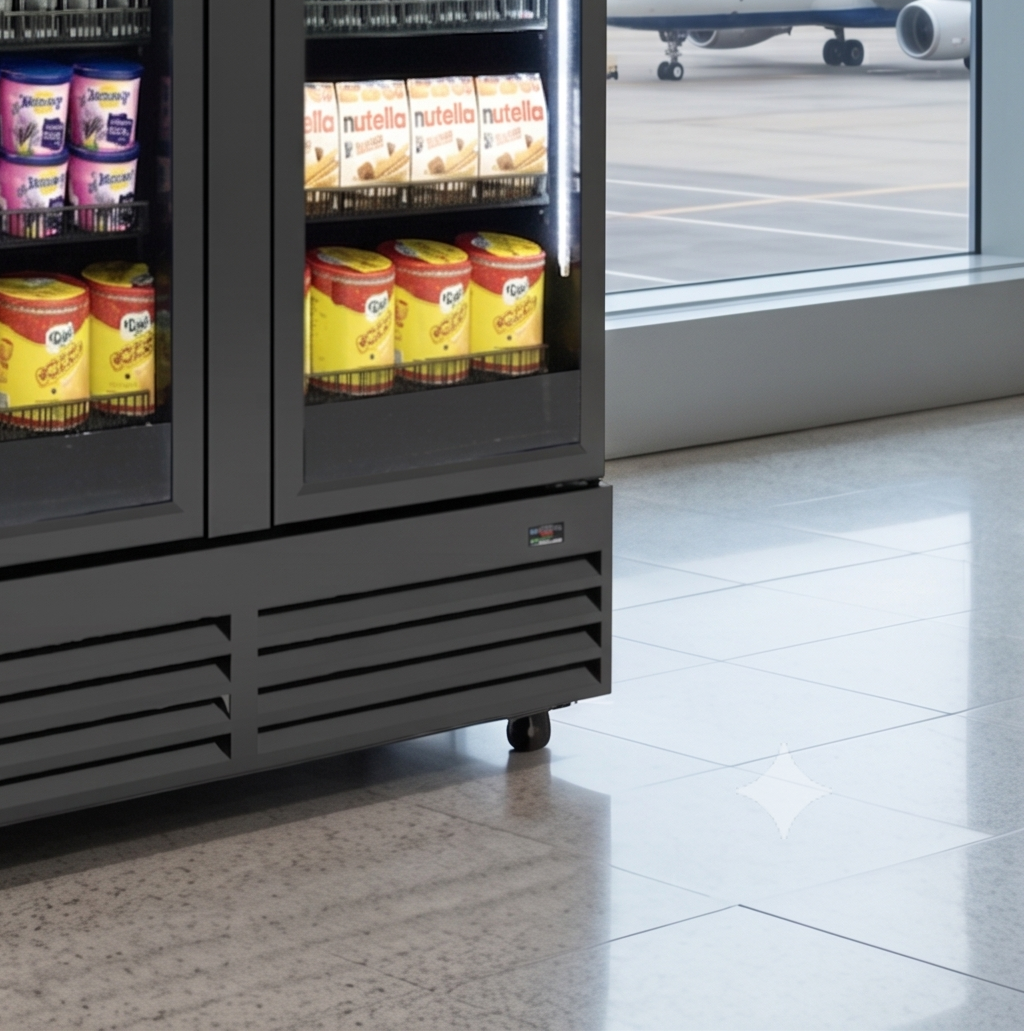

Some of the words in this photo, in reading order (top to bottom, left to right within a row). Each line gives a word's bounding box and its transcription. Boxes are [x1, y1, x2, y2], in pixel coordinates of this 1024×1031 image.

[343, 106, 407, 133] nutella
[414, 102, 475, 128] nutella
[482, 99, 544, 125] nutella
